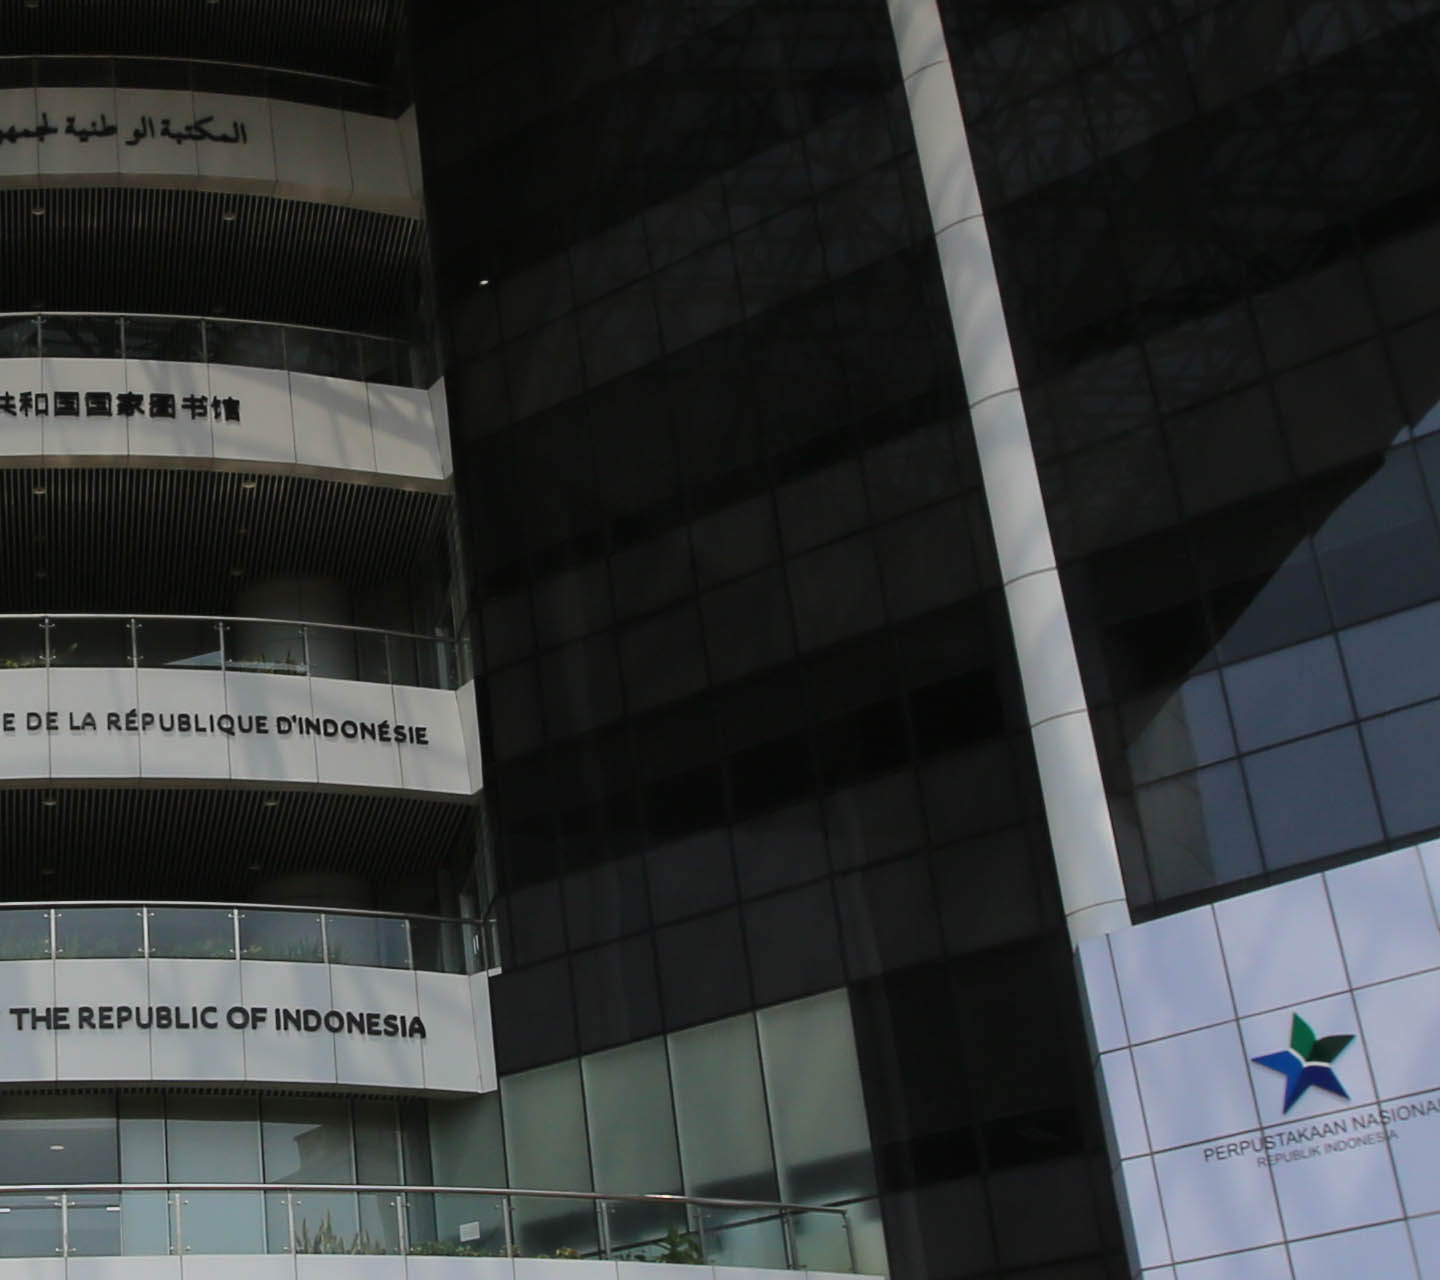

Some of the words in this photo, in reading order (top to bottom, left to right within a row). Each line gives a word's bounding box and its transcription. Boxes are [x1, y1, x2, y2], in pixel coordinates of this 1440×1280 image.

[26, 711, 58, 732] DE
[69, 711, 97, 732] LA
[107, 708, 270, 737] RÉPUBLIQUE
[10, 1007, 71, 1031] THE
[78, 1006, 219, 1030] REPUBLIC
[226, 1006, 268, 1030] OF
[275, 1007, 427, 1039] INDONESIA
[1202, 1121, 1349, 1163] PERPUSTAKAAN
[1256, 1145, 1321, 1169] REPUBLIK
[1323, 1128, 1399, 1155] INDONESIA
